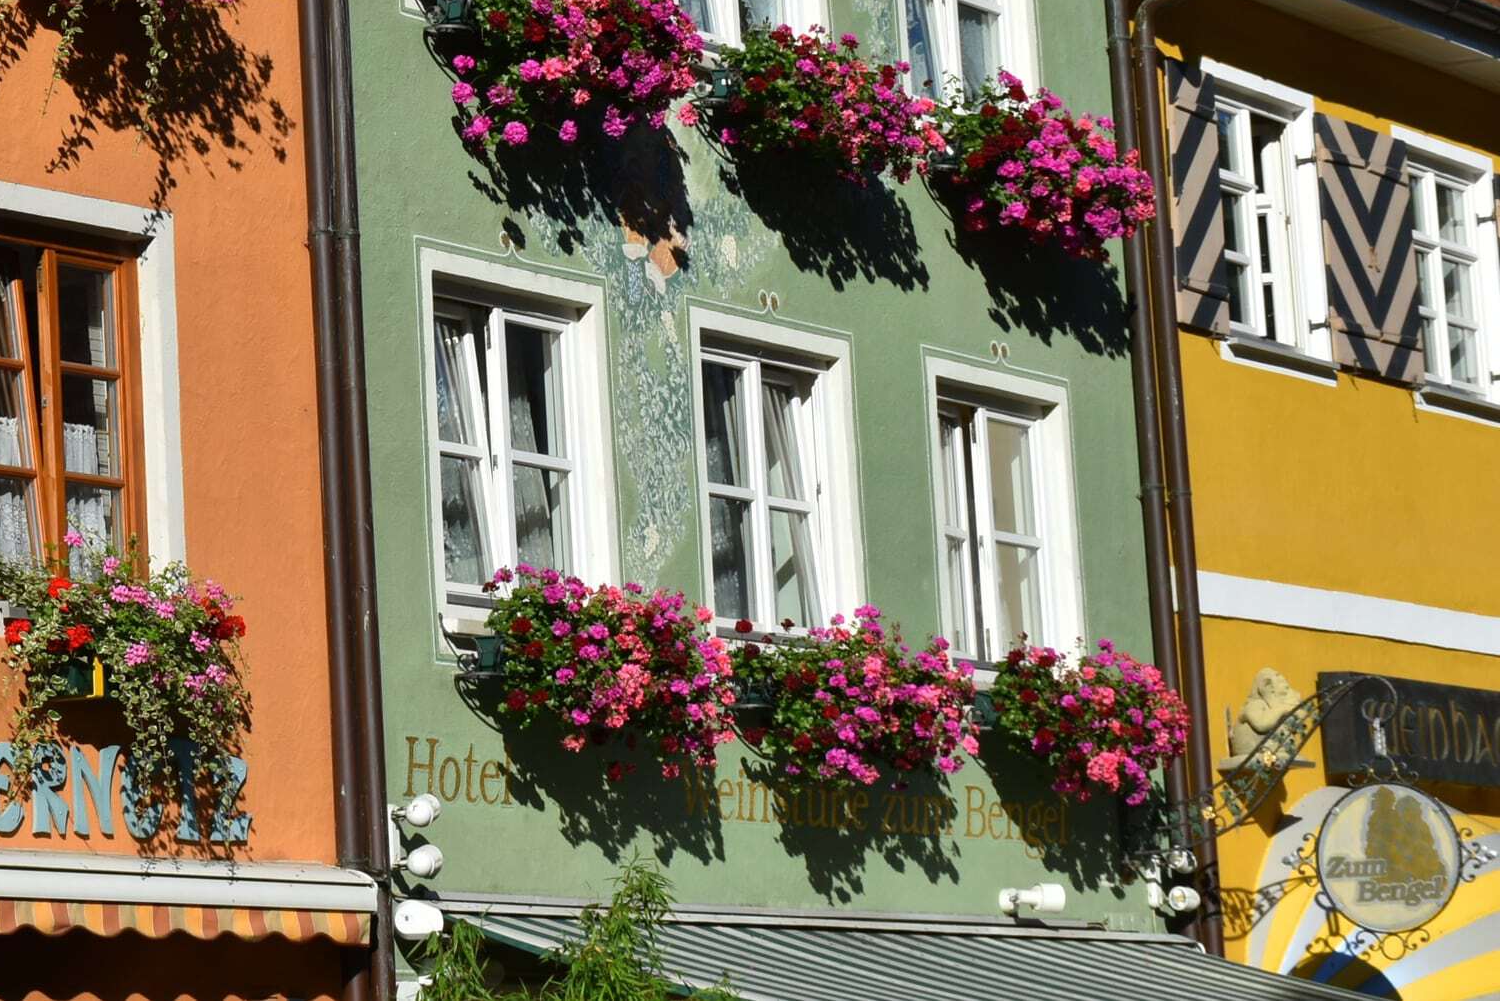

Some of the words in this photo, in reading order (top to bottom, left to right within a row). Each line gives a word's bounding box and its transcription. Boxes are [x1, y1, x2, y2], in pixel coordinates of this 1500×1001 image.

[403, 735, 513, 805] Hotel
[880, 791, 956, 835] zum
[964, 784, 1070, 860] Bengel
[1327, 856, 1388, 879] Zum
[1358, 876, 1445, 906] Bengel
